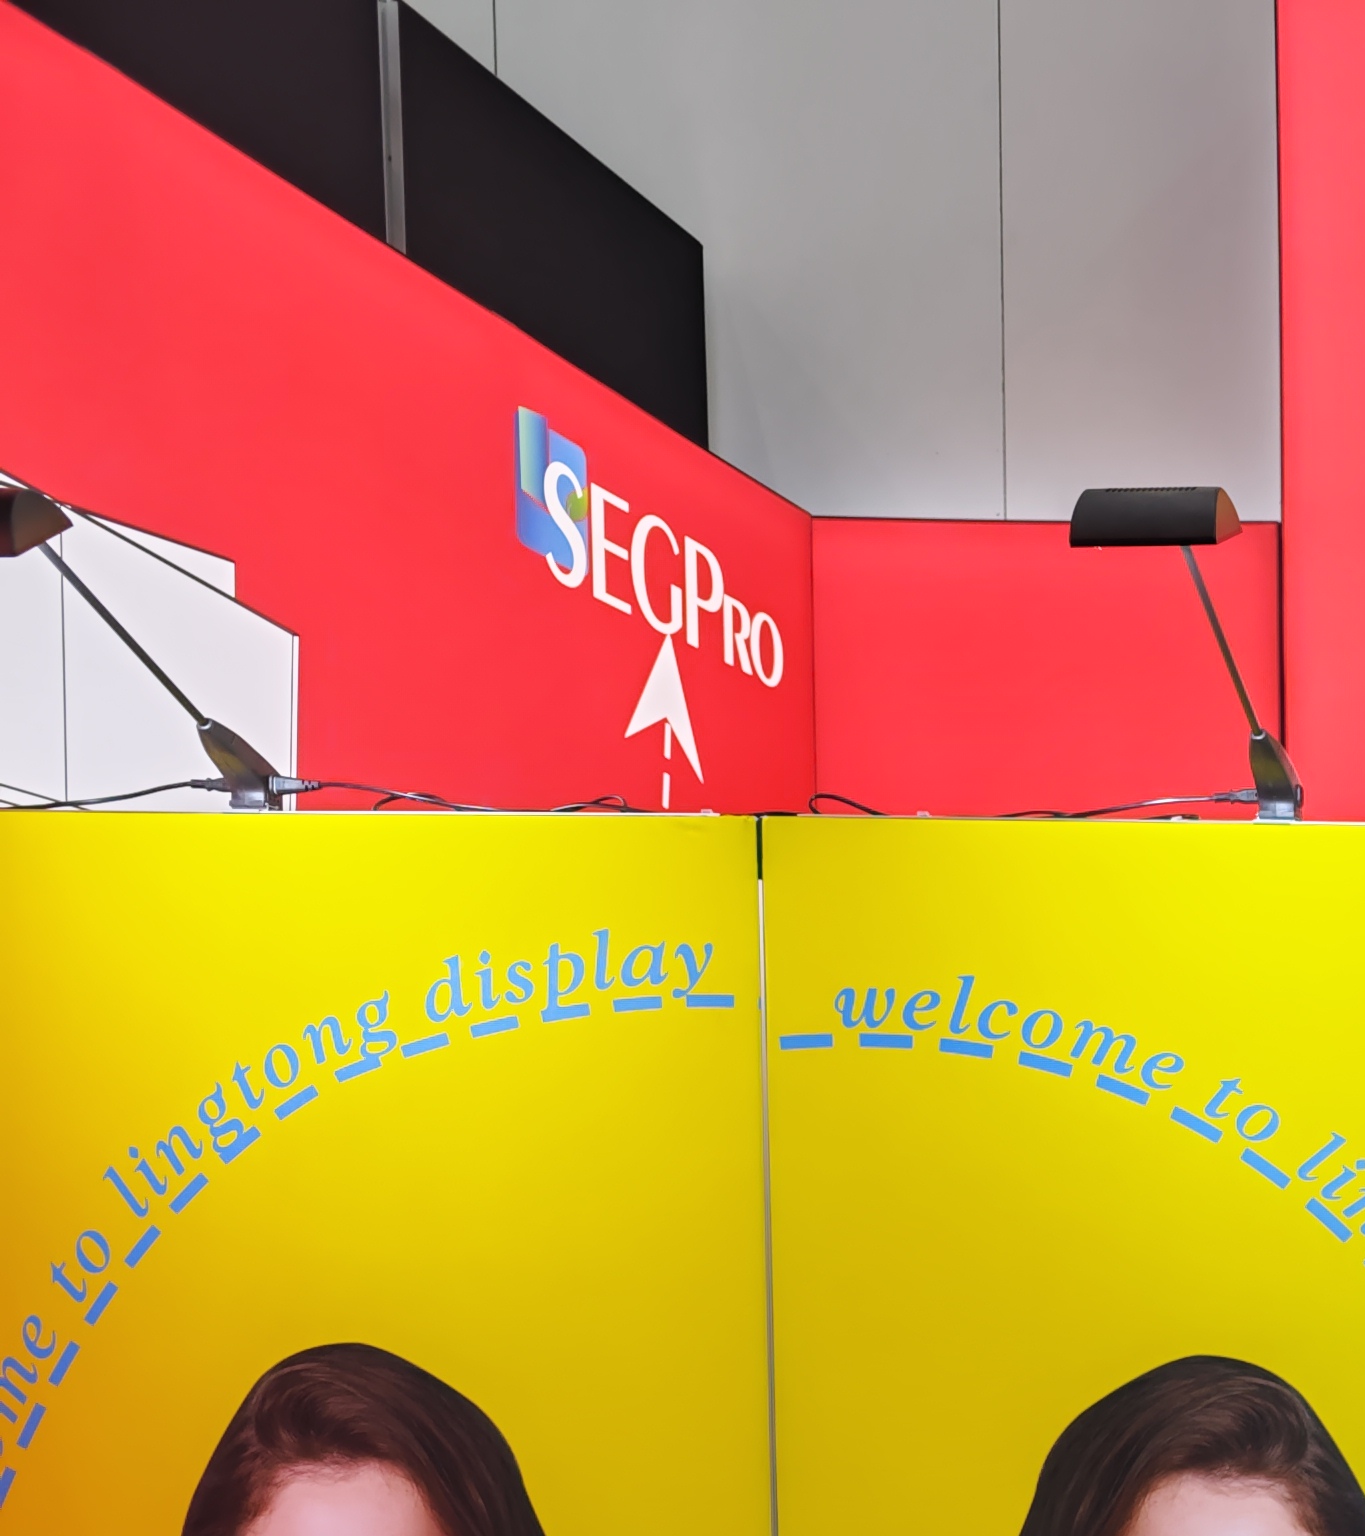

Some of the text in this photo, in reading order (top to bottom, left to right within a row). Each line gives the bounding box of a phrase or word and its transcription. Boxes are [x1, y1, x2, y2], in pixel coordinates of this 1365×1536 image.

[0, 928, 715, 1424] me to lingtong display
[834, 975, 1185, 1090] welcome
[1204, 1076, 1281, 1142] to
